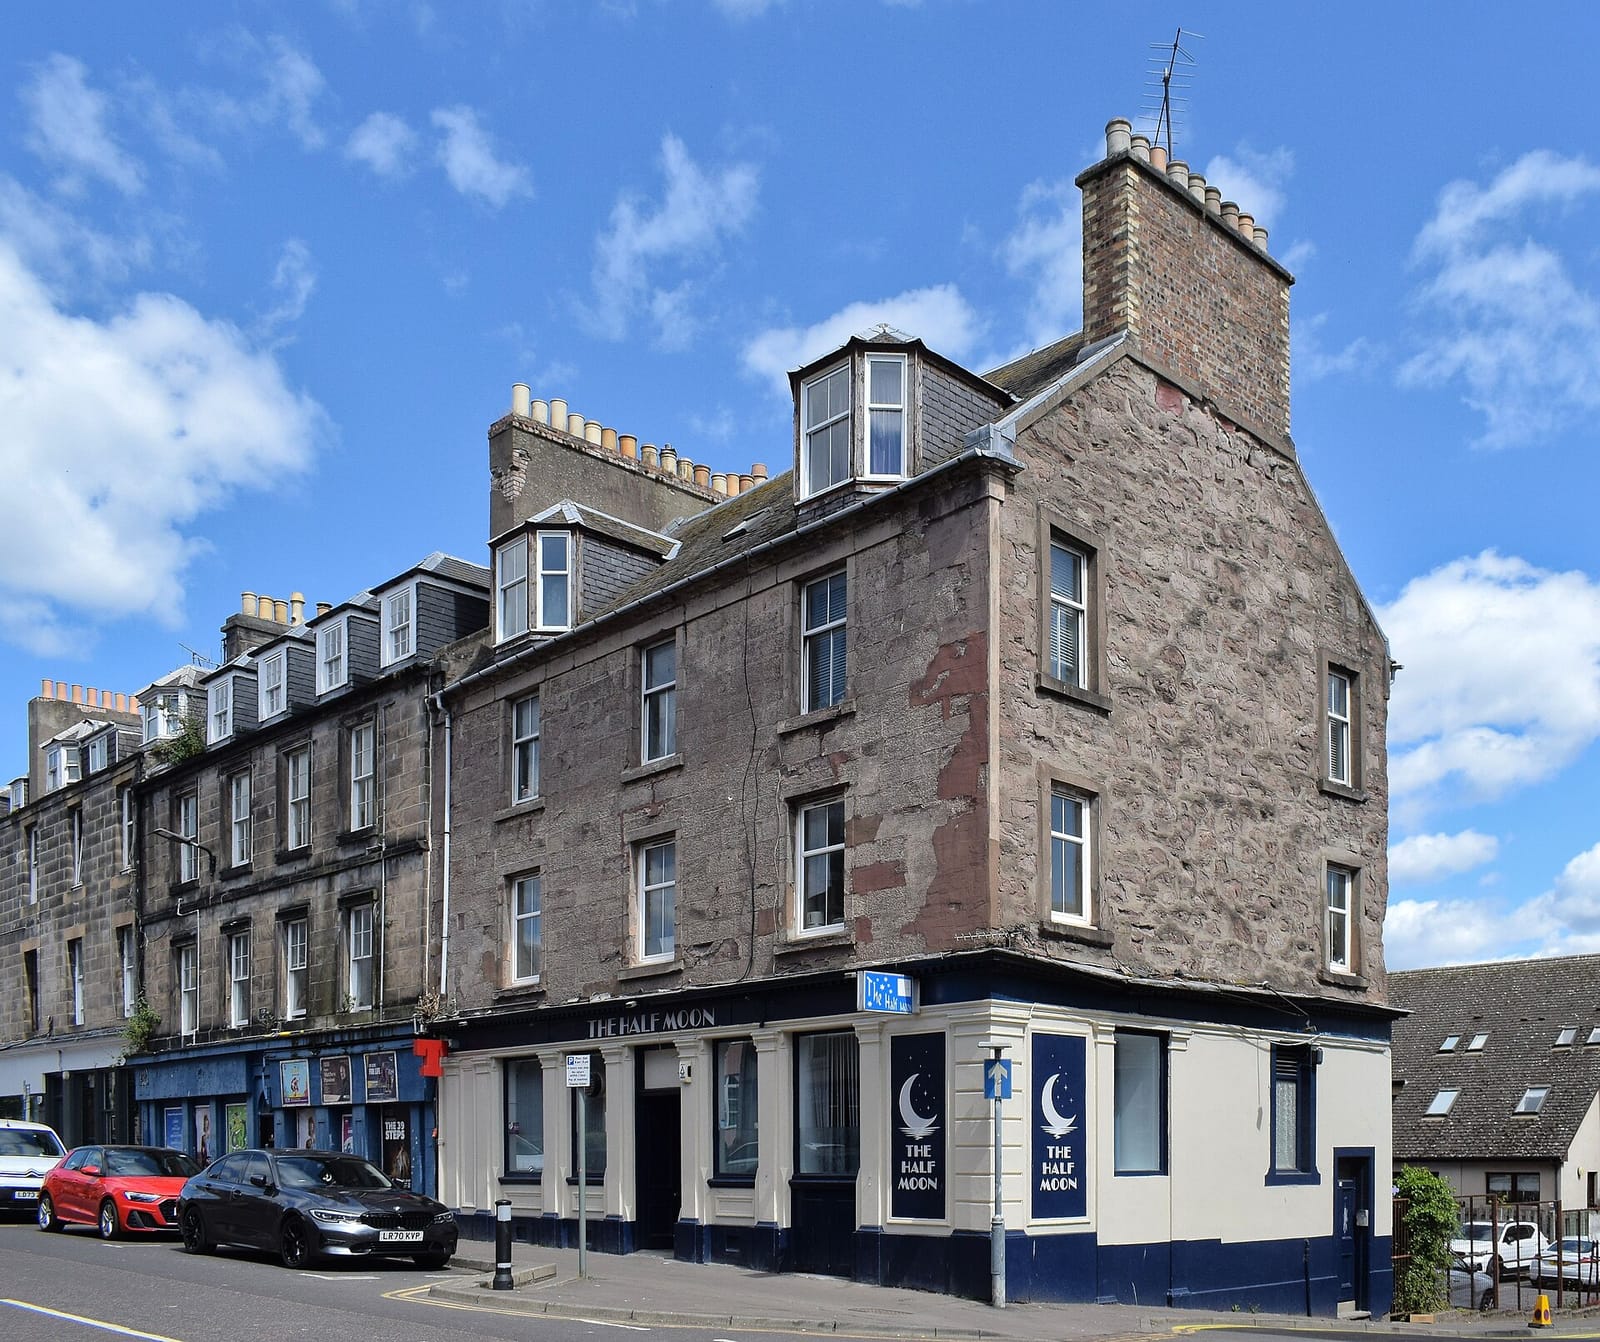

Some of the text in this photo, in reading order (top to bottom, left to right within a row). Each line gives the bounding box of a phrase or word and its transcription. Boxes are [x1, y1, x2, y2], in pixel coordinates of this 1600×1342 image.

[587, 1007, 715, 1038] THE HALF MOON
[385, 1121, 405, 1130] THE 39
[385, 1130, 405, 1140] STEPS
[905, 1144, 932, 1158] THE
[1046, 1145, 1072, 1159] THE
[901, 1160, 936, 1174] HALF
[1042, 1161, 1075, 1175] HALF
[897, 1176, 938, 1190] MOON
[1039, 1177, 1078, 1191] MOON
[383, 1232, 404, 1240] LR70
